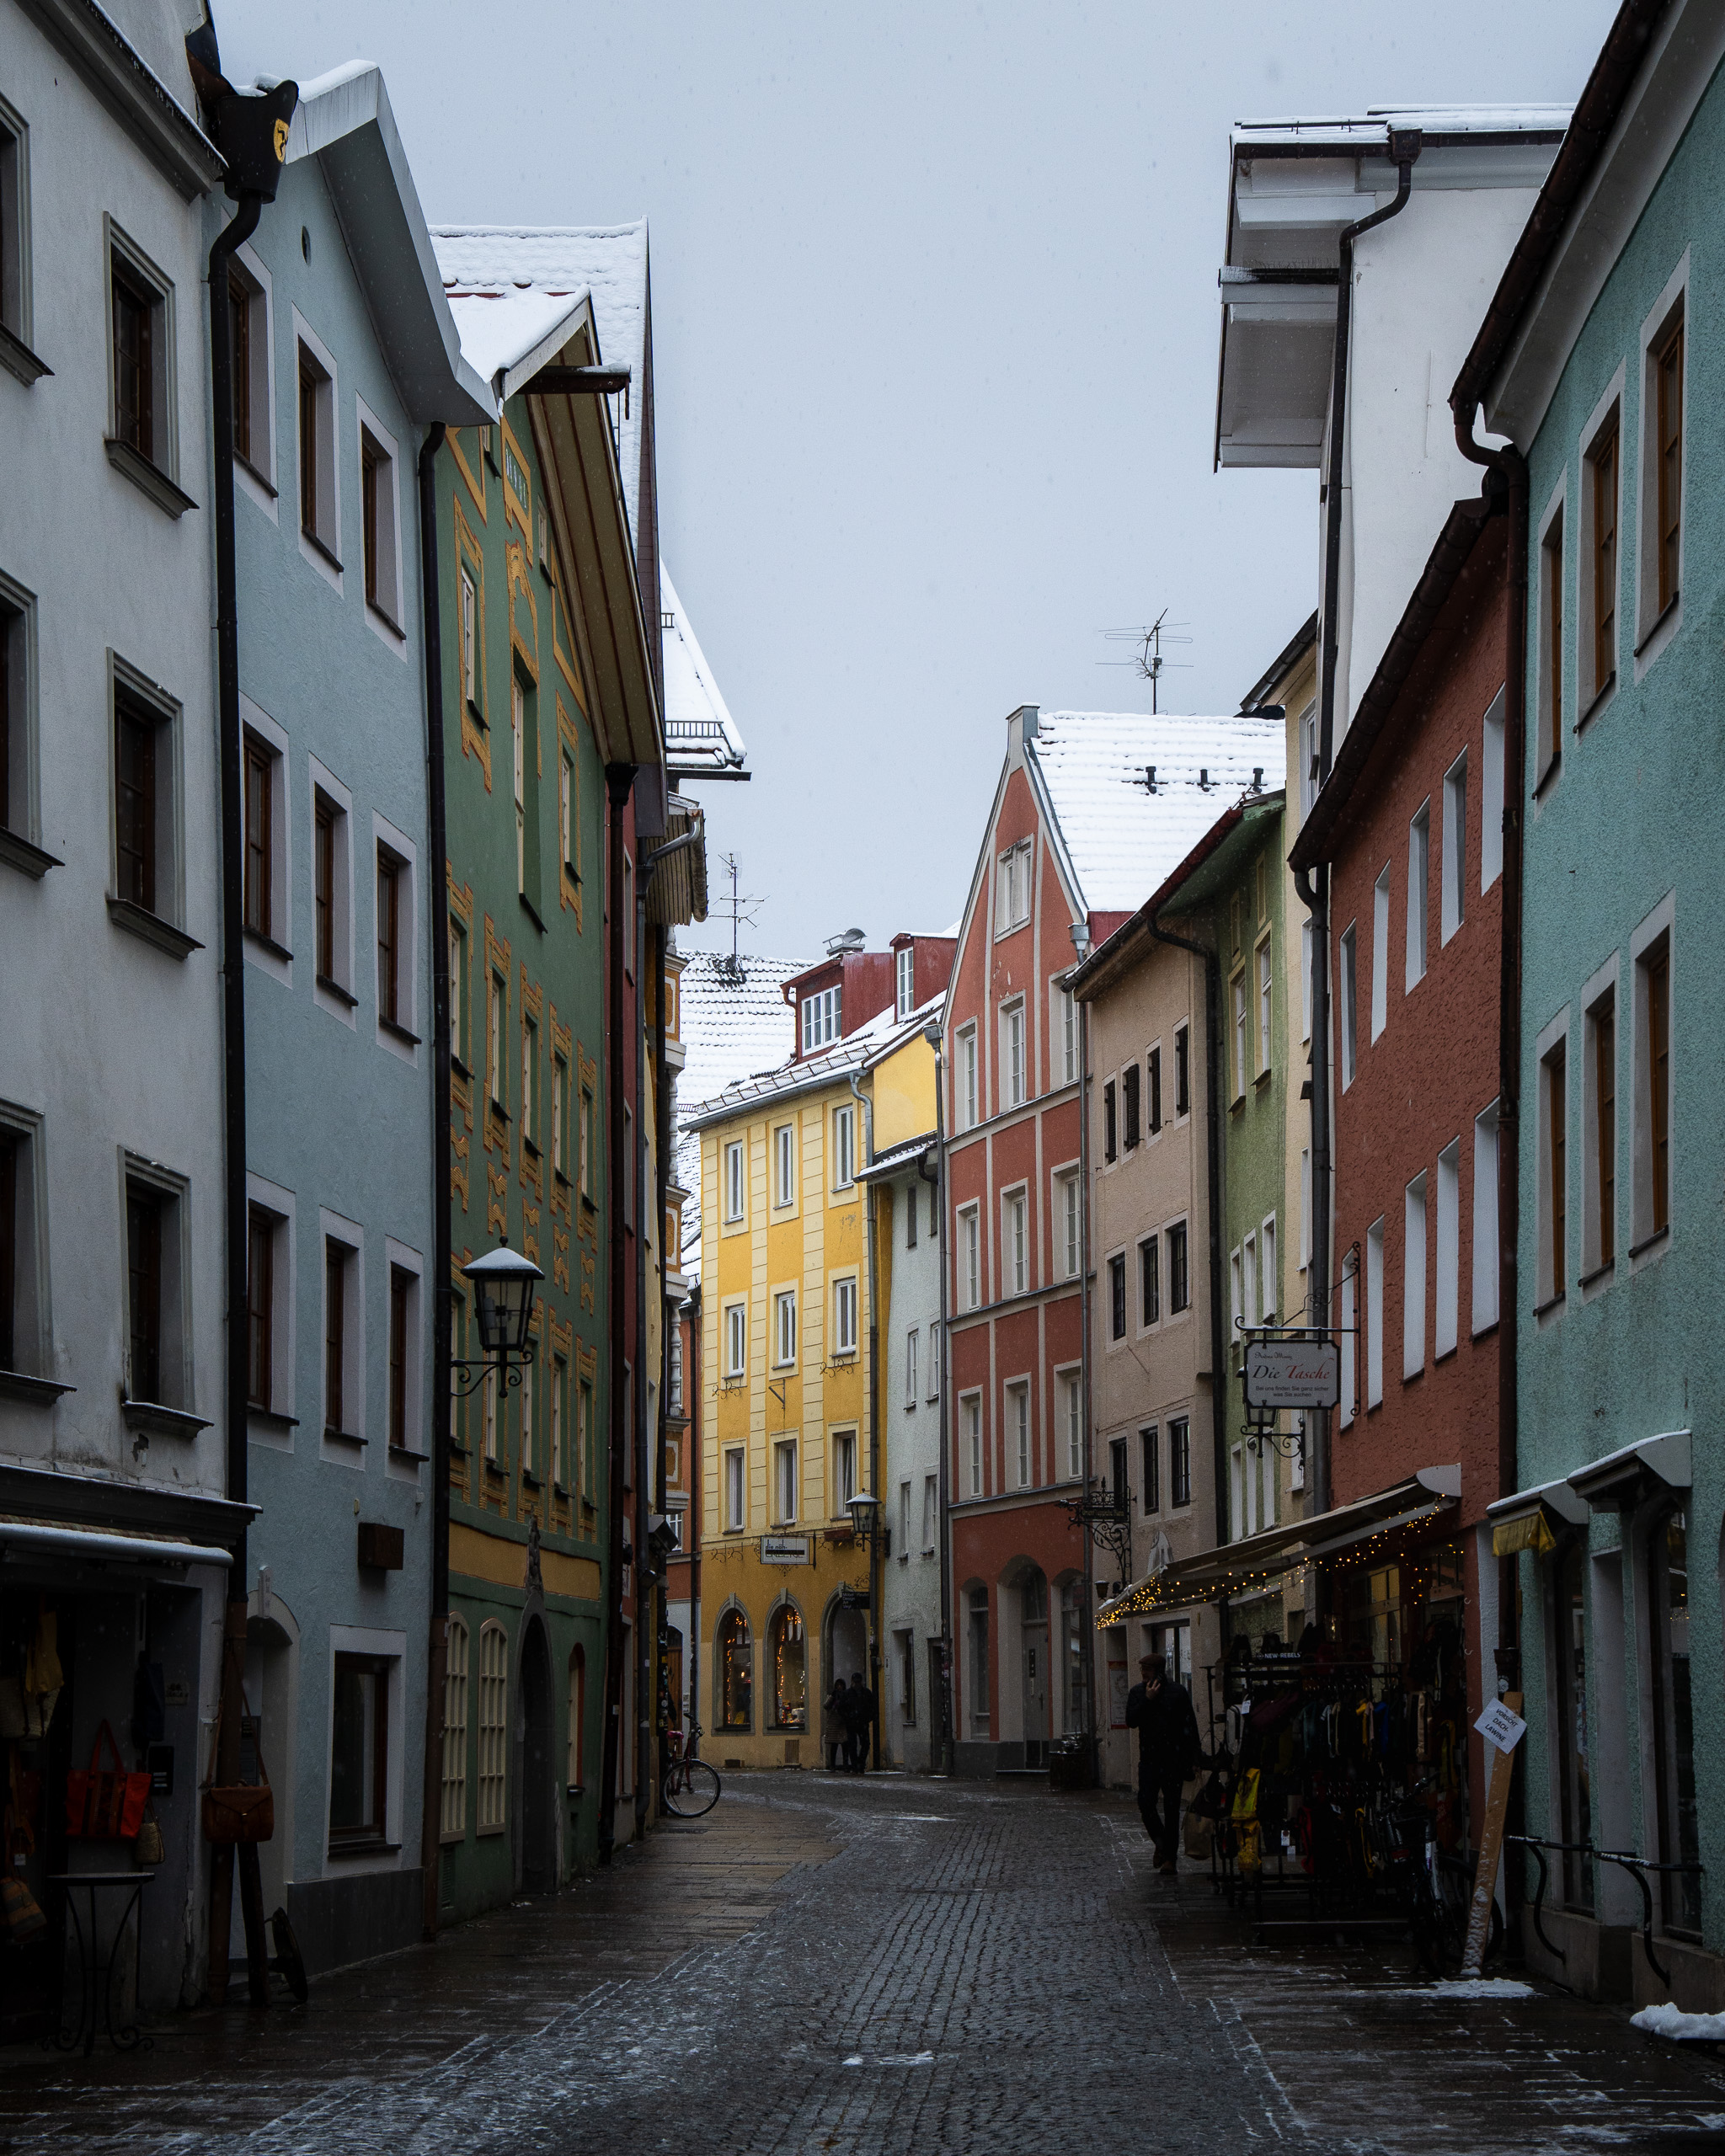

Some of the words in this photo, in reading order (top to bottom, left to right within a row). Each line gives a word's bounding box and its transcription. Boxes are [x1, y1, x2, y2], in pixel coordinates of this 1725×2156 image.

[1252, 1364, 1280, 1379] Die
[1285, 1358, 1334, 1379] Tasche
[765, 1539, 774, 1549] die
[1493, 1717, 1509, 1732] DACH-
[1496, 1708, 1518, 1726] VORSICHT
[1485, 1724, 1506, 1742] LAWINE
